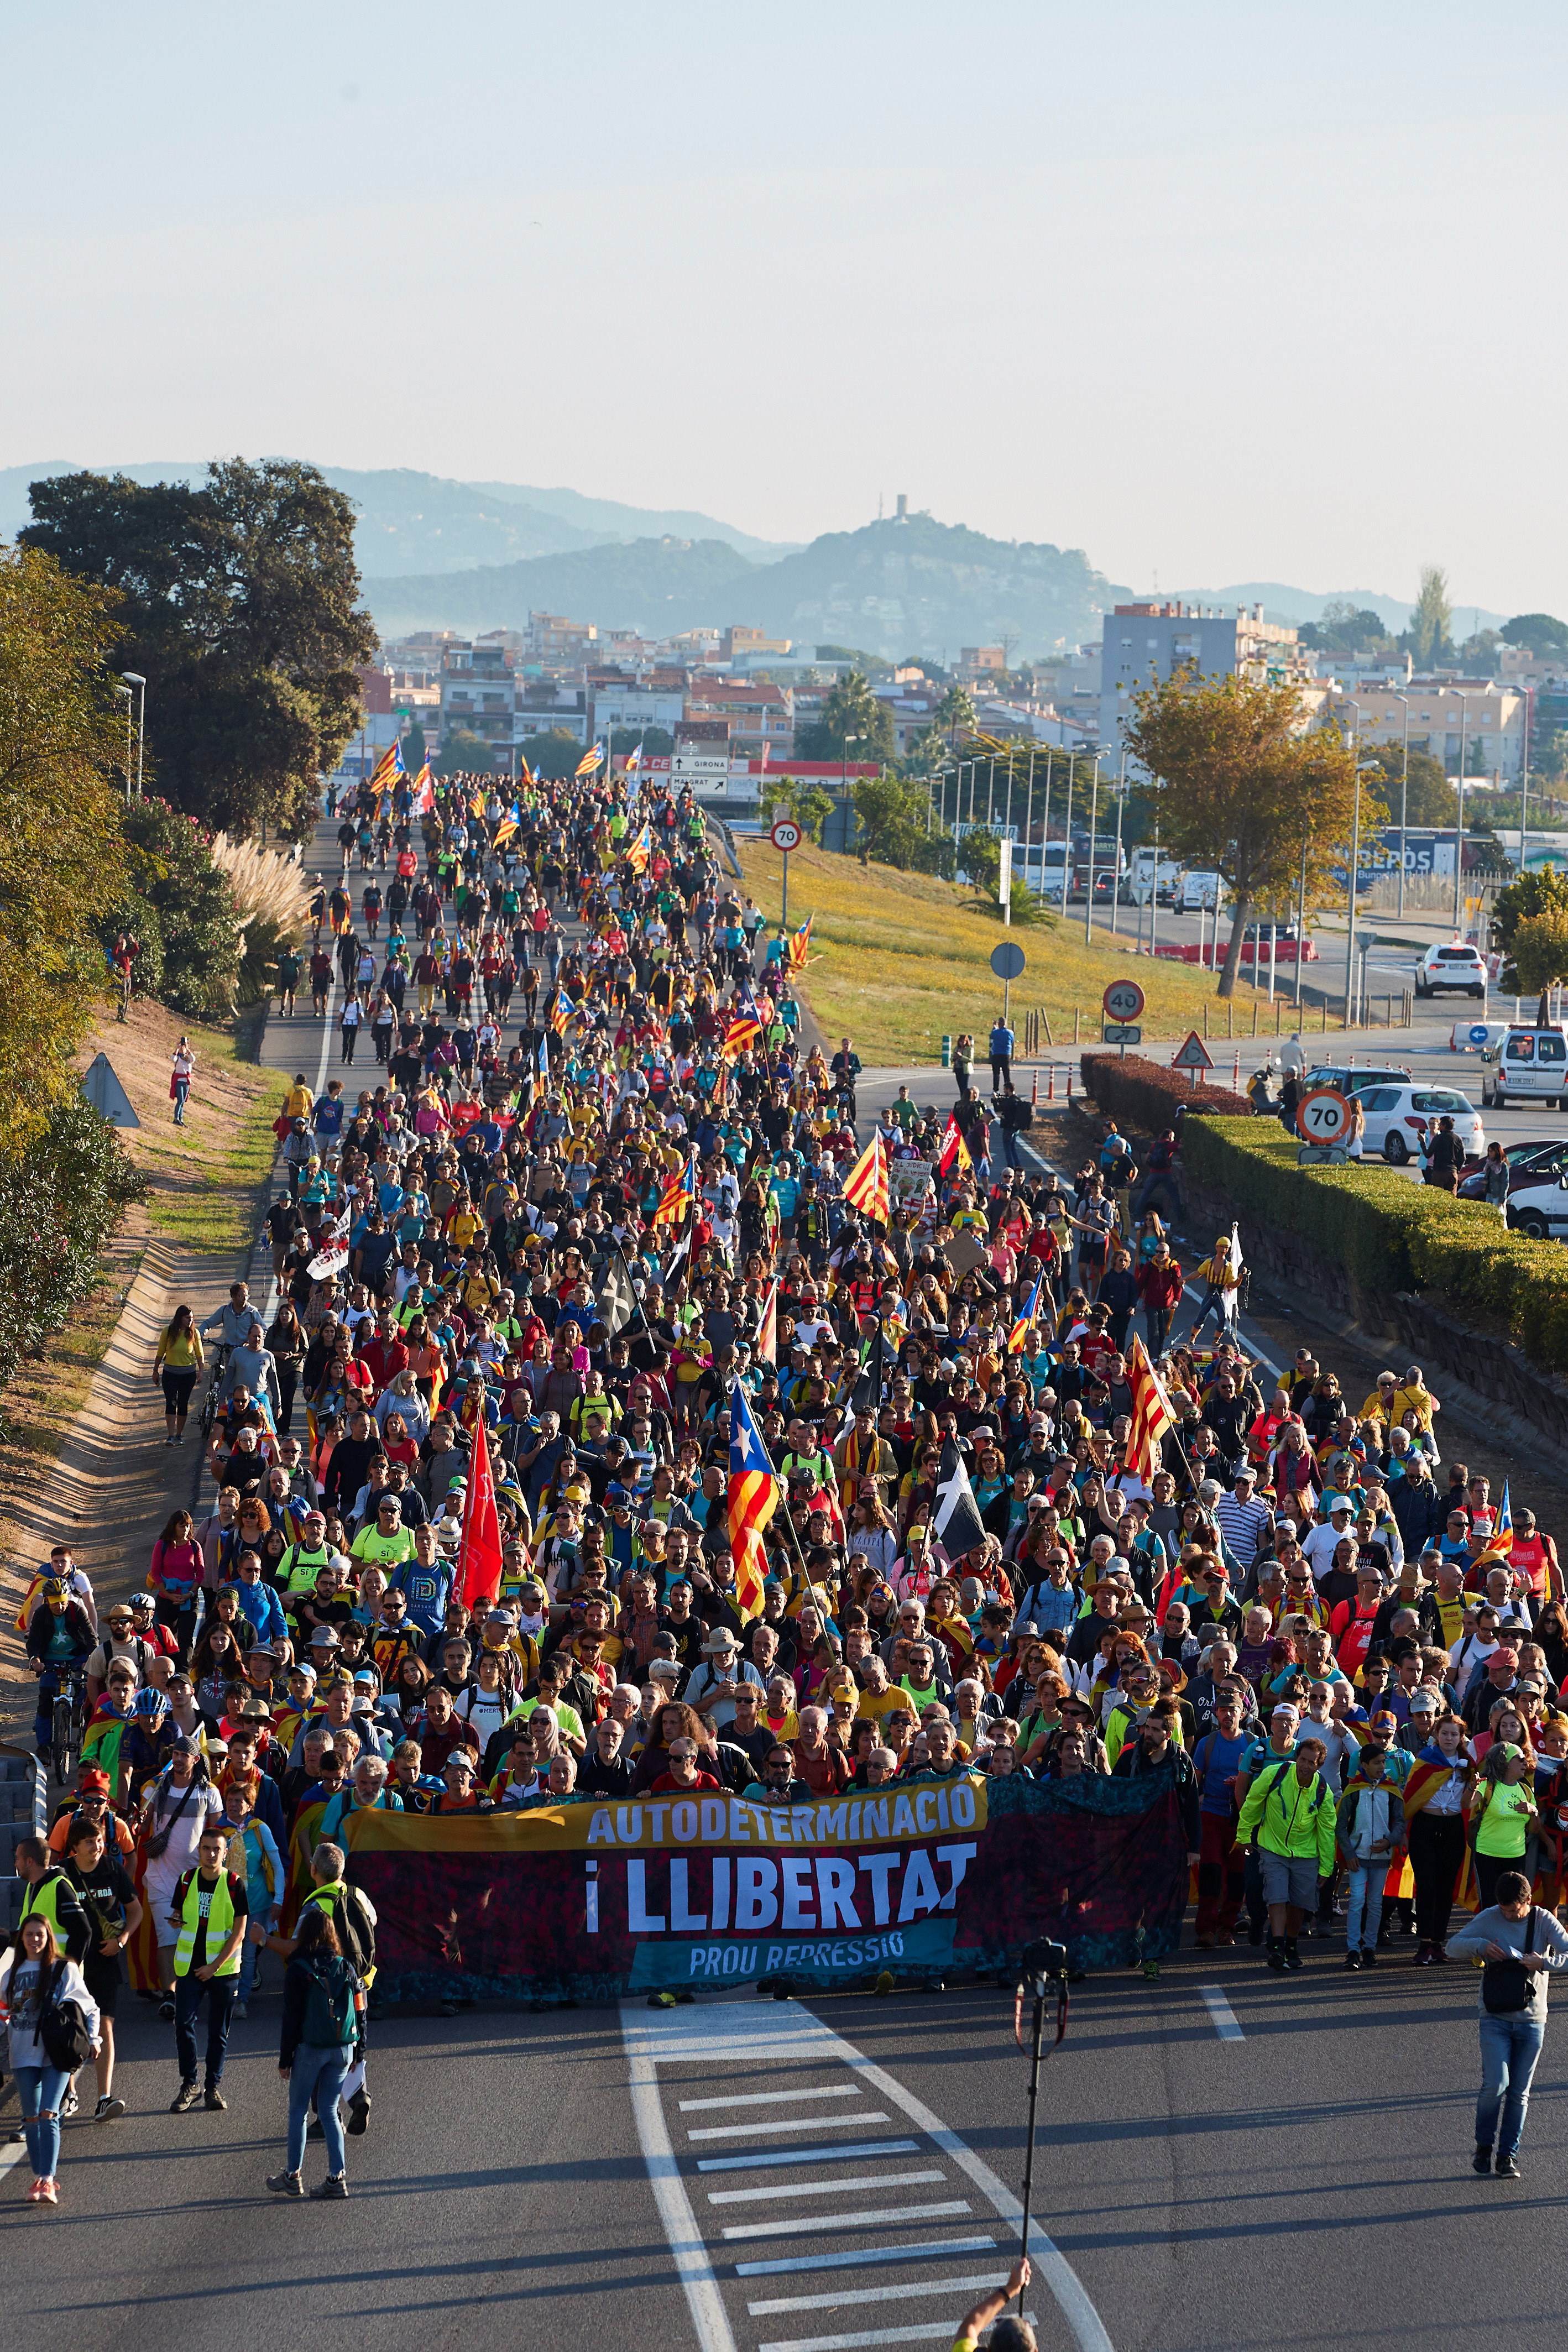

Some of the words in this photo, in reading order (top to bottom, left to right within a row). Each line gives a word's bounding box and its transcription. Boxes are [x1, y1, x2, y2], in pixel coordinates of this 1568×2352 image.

[651, 758, 670, 769] CE
[779, 830, 795, 843] 70
[1110, 994, 1137, 1008] 40
[1311, 1108, 1339, 1127] 70
[587, 1771, 976, 1844] AUTODETERMINACIÓ
[627, 1842, 978, 1933] LLIBERTAT
[689, 1946, 758, 1977] PROU
